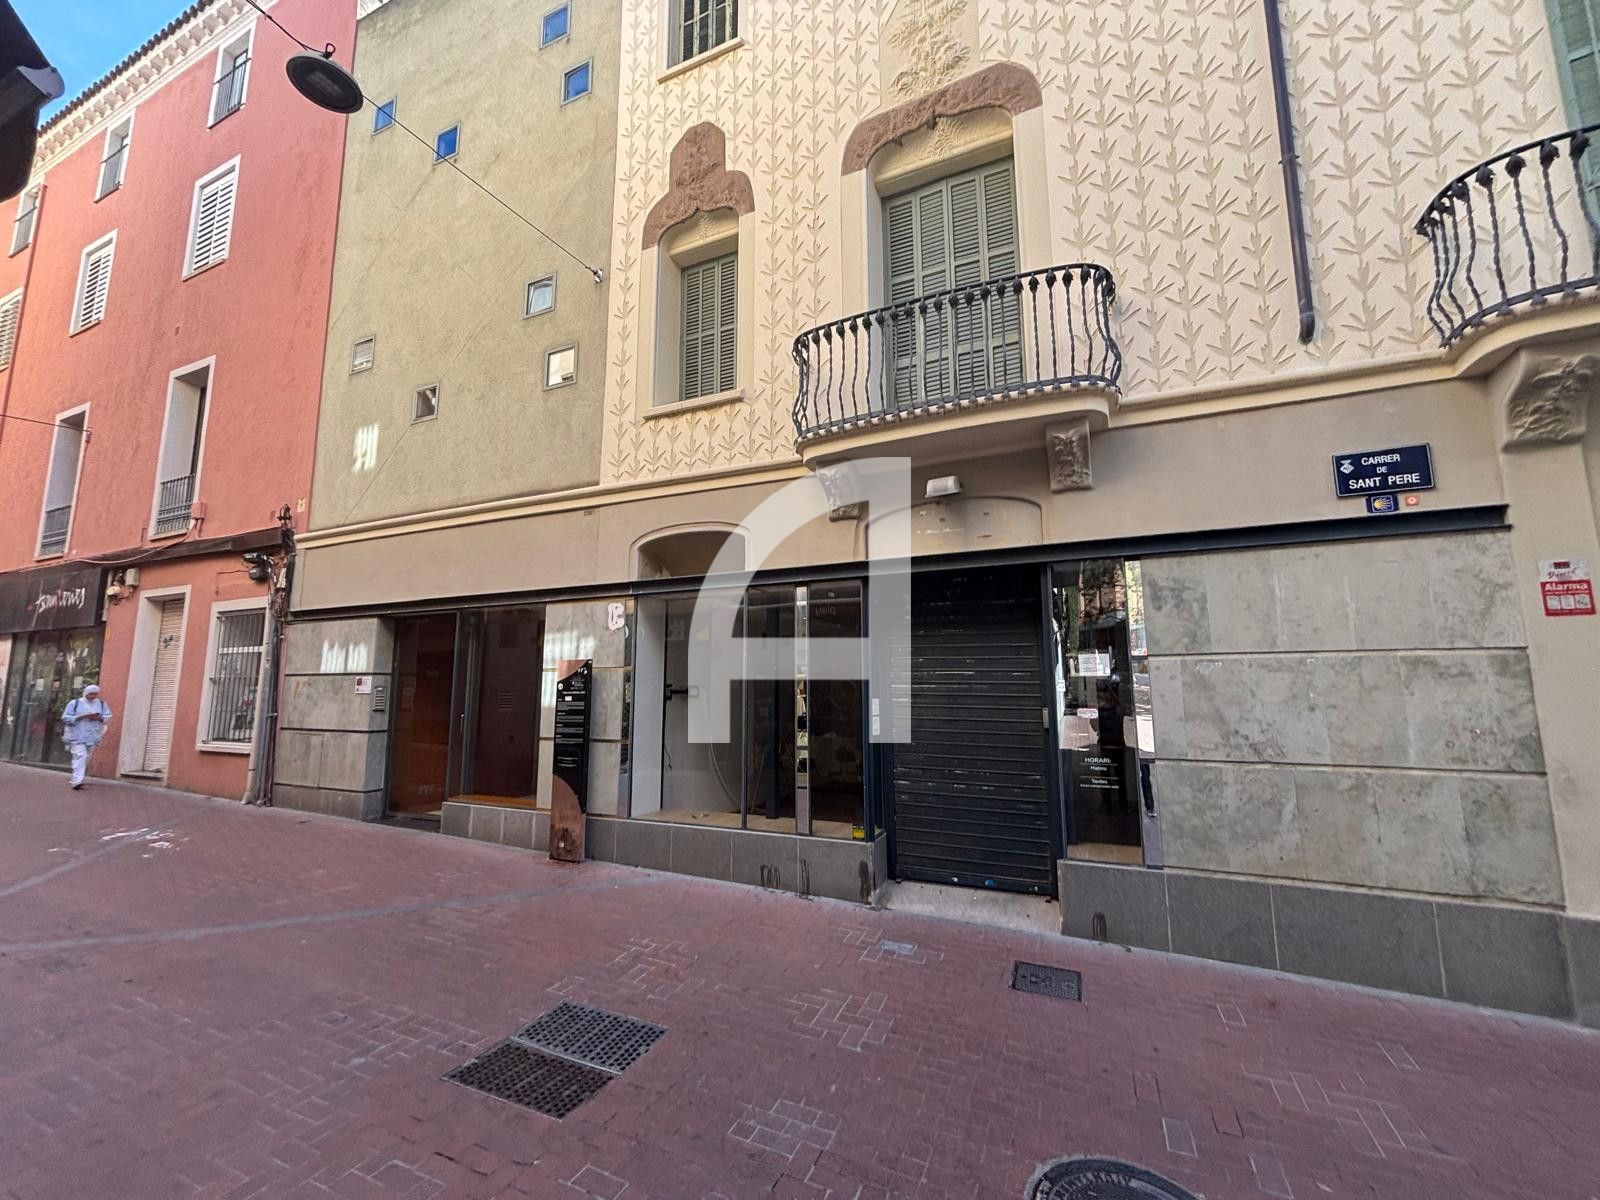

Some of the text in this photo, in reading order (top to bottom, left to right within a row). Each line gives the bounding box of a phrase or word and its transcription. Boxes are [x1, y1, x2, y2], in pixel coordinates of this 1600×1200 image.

[1361, 454, 1400, 464] CARRER
[1348, 473, 1420, 489] SANT PERE
[1545, 582, 1588, 590] Alarma
